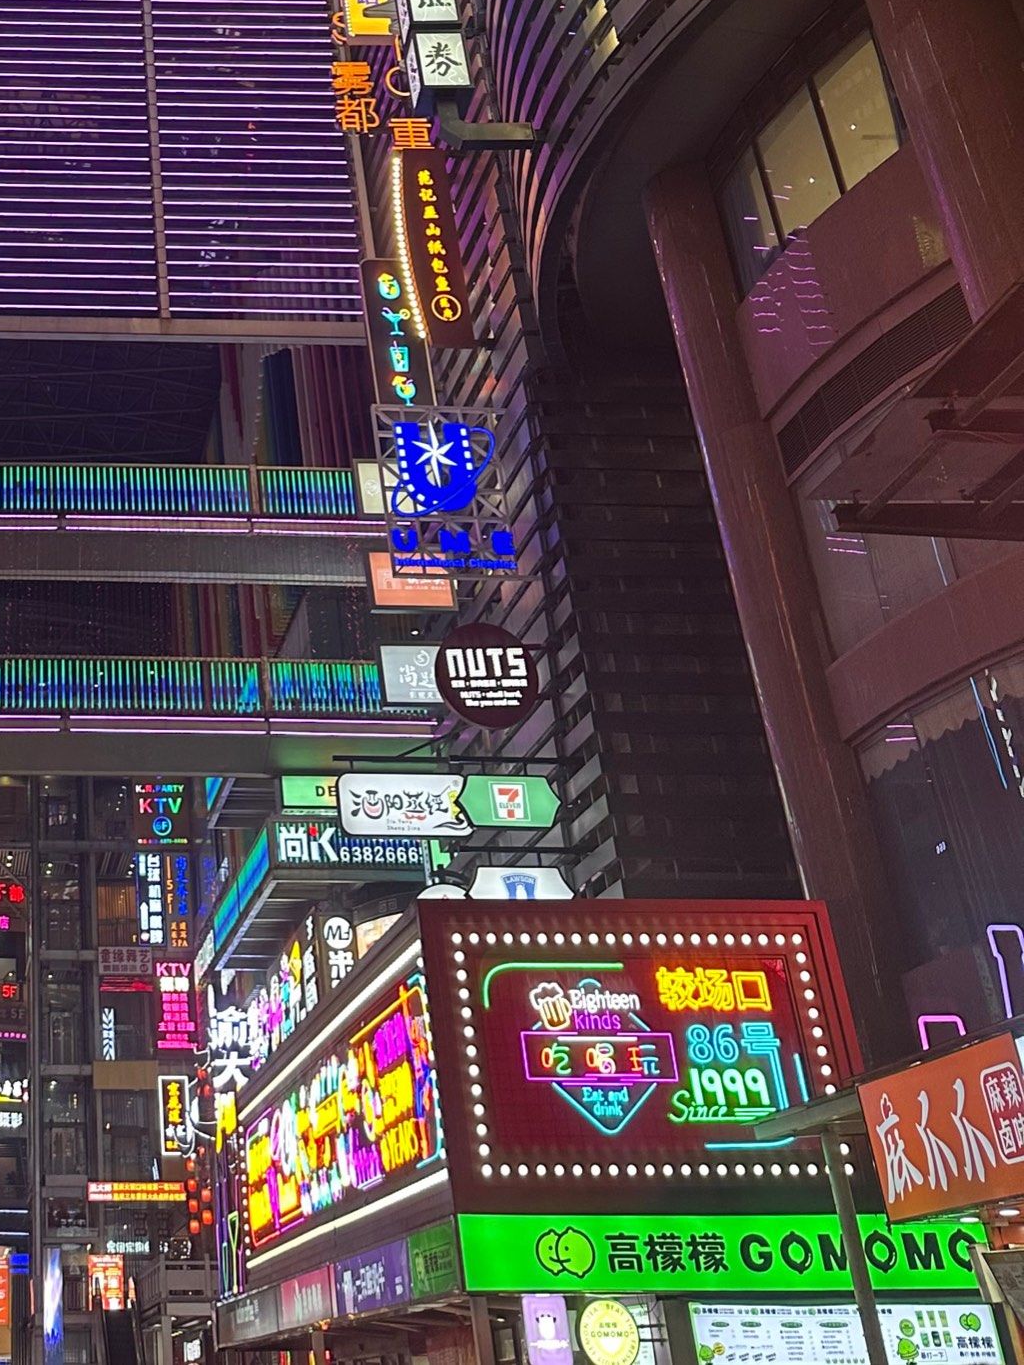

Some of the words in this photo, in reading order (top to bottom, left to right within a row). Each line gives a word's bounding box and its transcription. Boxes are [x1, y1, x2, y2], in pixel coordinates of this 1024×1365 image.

[331, 62, 380, 132] 雾都
[392, 528, 517, 555] UME
[139, 797, 182, 813] KTV
[504, 876, 538, 885] LAWSON
[156, 962, 191, 976] KTV
[2, 985, 18, 998] 5F
[570, 988, 641, 1012] Eighteen
[656, 967, 773, 1012] 较场口
[574, 1013, 622, 1031] kinds
[542, 1043, 661, 1075] 吃喝玩
[687, 1020, 791, 1110] 86号
[582, 1086, 606, 1102] Eat
[607, 1087, 629, 1102] and
[688, 1067, 772, 1106] 1999
[985, 1071, 1023, 1114] 麻辣
[593, 1101, 625, 1116] drink
[668, 1090, 729, 1124] Since
[605, 1232, 729, 1274] 高檬檬
[739, 1230, 978, 1275] GOMOMO
[956, 1336, 995, 1349] 高檬檬
